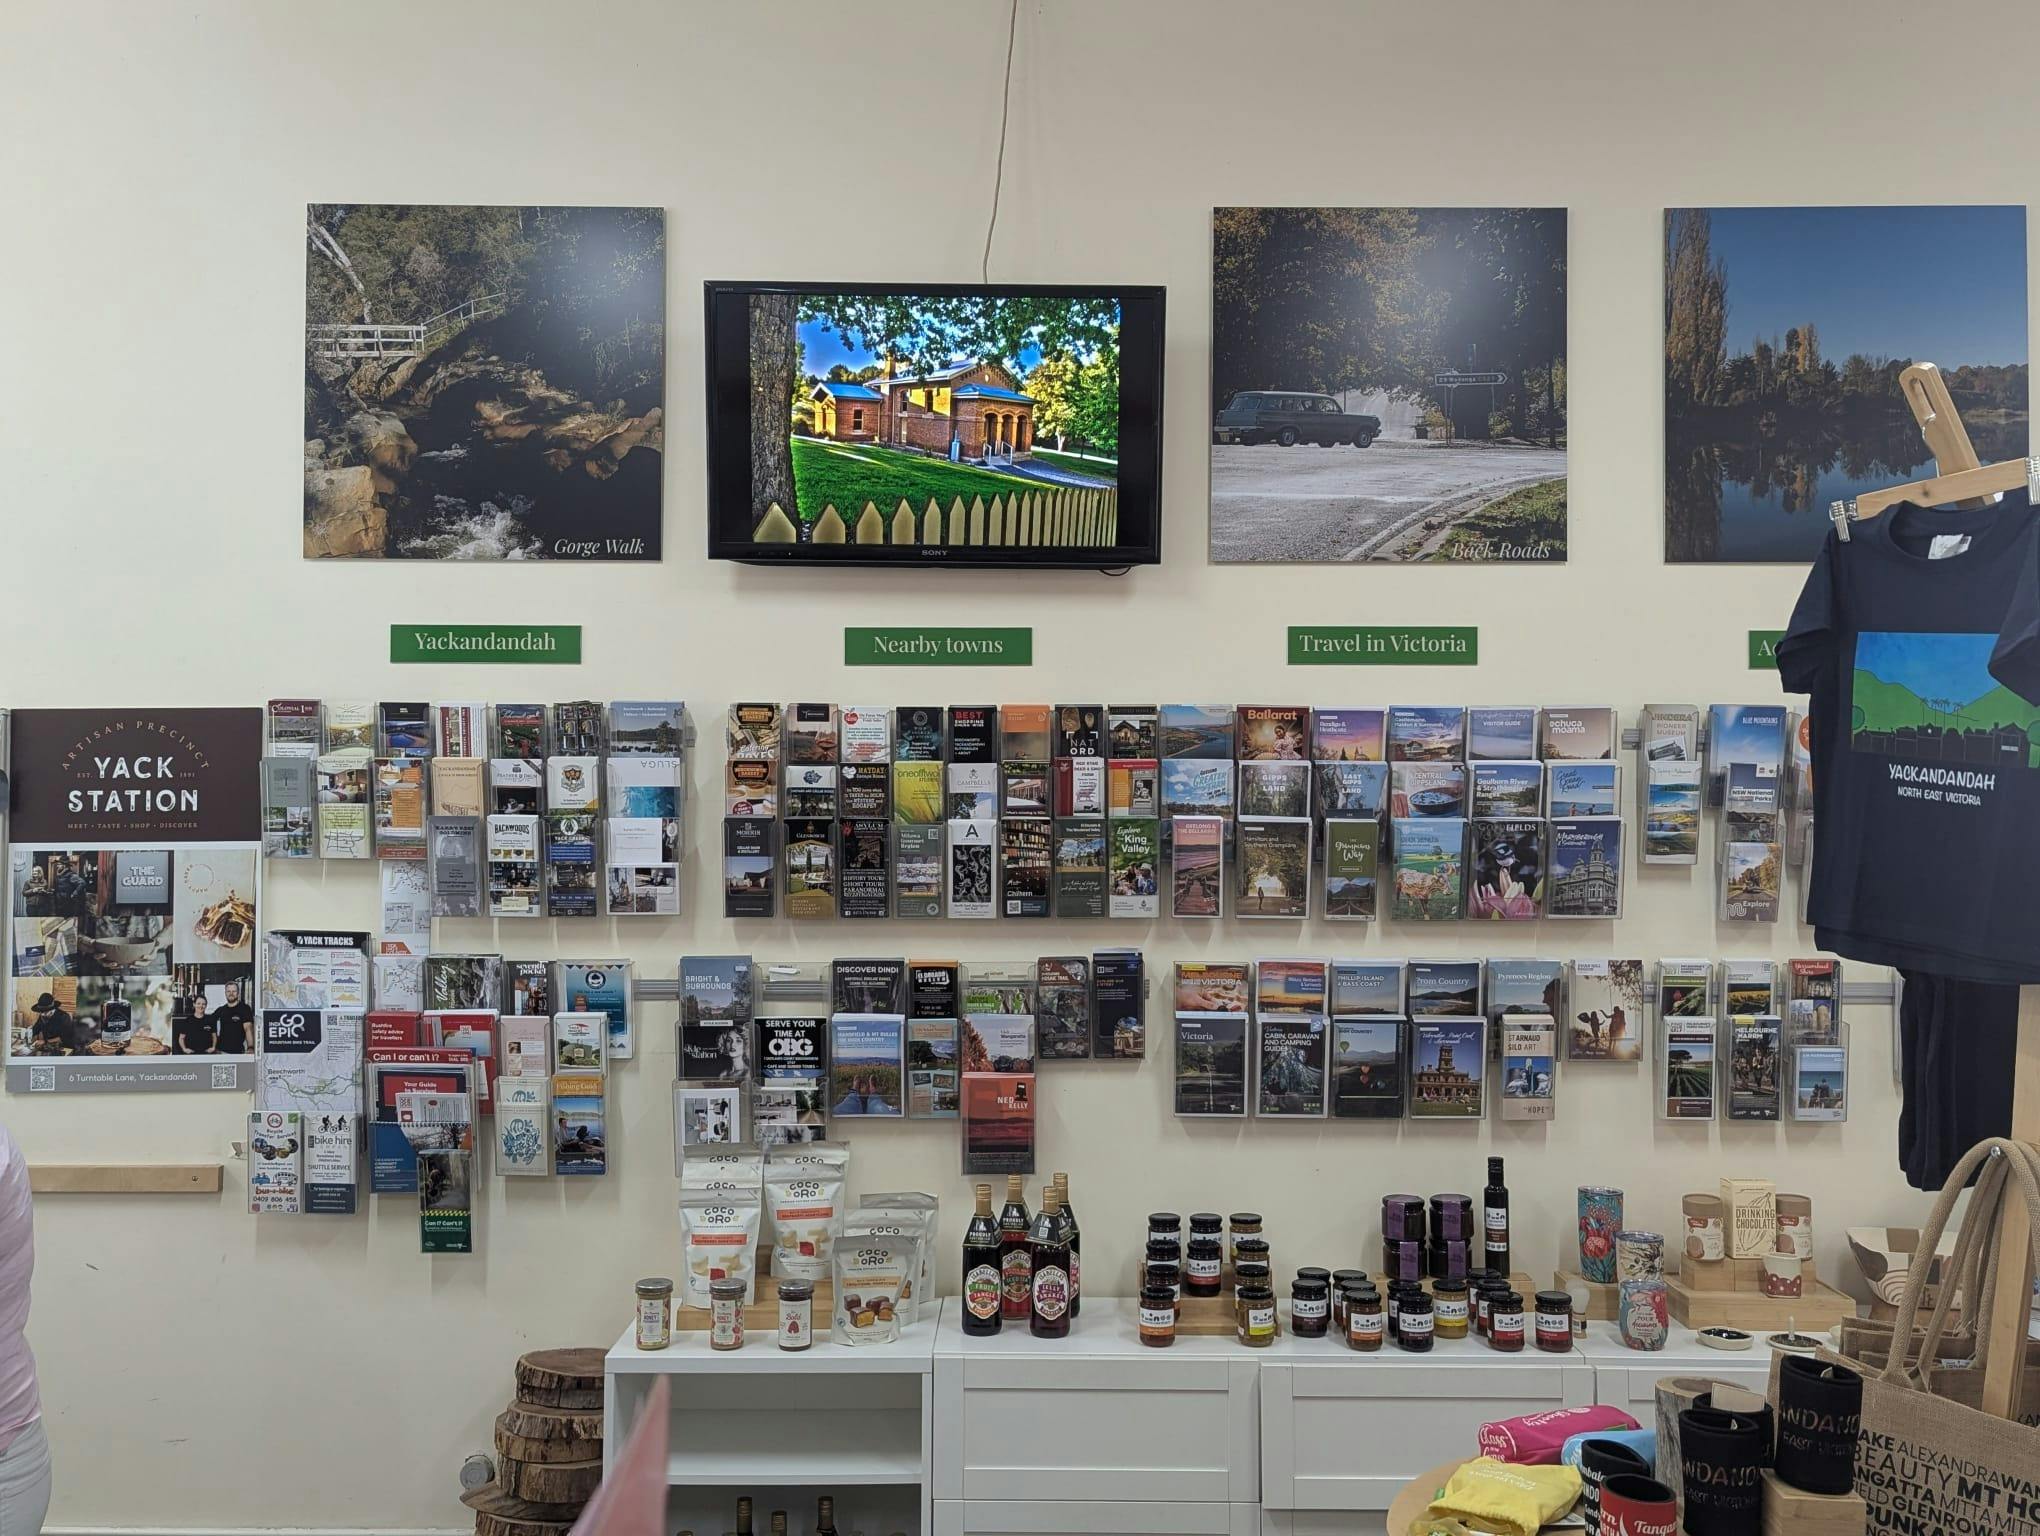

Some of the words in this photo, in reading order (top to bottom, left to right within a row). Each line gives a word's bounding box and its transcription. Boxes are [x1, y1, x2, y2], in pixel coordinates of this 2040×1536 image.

[555, 539, 600, 556] Gorge
[606, 539, 644, 554] Walk
[1452, 543, 1493, 558] Back
[1500, 543, 1551, 559] Roads
[415, 633, 556, 650] Yackandandah
[874, 636, 942, 656] Nearby
[947, 638, 1003, 653] towns
[1300, 635, 1360, 653] Travel
[1367, 635, 1384, 653] in
[1391, 635, 1466, 653] Victoria
[1248, 710, 1297, 720] Ballarat
[62, 722, 124, 770] ARTISAN
[136, 721, 209, 769] PRECINCT
[94, 756, 174, 779] YACK
[1889, 763, 1995, 791] YACKANDANDAH
[1477, 791, 1500, 799] Ranges
[1898, 786, 1922, 799] NORTH
[1924, 789, 1943, 802] EAST
[1946, 792, 1981, 806] VICTORIA
[68, 790, 198, 812] STATION
[495, 824, 529, 834] BACKWOODS
[966, 824, 979, 837] A
[1117, 826, 1141, 836] Explore
[1125, 835, 1147, 844] King
[1122, 845, 1150, 854] Valley
[1344, 851, 1364, 862] Way
[131, 867, 154, 875] THE
[122, 876, 163, 886] GUARD
[304, 936, 323, 946] YACK
[324, 937, 353, 946] TRACKS
[516, 961, 545, 970] seventh
[520, 968, 546, 976] pocket
[1416, 977, 1437, 985] Prom
[1438, 977, 1469, 986] Country
[1498, 973, 1527, 982] Pyrenees
[1528, 973, 1551, 981] Region
[280, 1014, 304, 1027] GO
[766, 1020, 790, 1028] SERVE
[792, 1020, 816, 1028] YOUR
[269, 1027, 301, 1037] EPIC
[1181, 1032, 1213, 1041] Victoria
[1508, 1043, 1522, 1051] SILO
[692, 1051, 717, 1059] station
[69, 1074, 73, 1082] 6
[76, 1073, 112, 1082] Turntable
[115, 1073, 137, 1083] Lane,
[139, 1073, 198, 1081] Yackandandah
[997, 1096, 1014, 1104] NED
[315, 1136, 333, 1145] bike
[335, 1136, 352, 1145] hire
[1736, 1208, 1776, 1218] DRINKING
[1736, 1219, 1776, 1230] CHOCOLATE
[1858, 1429, 1895, 1450] AKE
[1897, 1442, 2000, 1486] ALEXANDRA
[2001, 1473, 2040, 1500] WAN
[1855, 1445, 1952, 1490] BEAUTY
[1958, 1476, 2000, 1508] MT
[1940, 1493, 1991, 1525] MITTA
